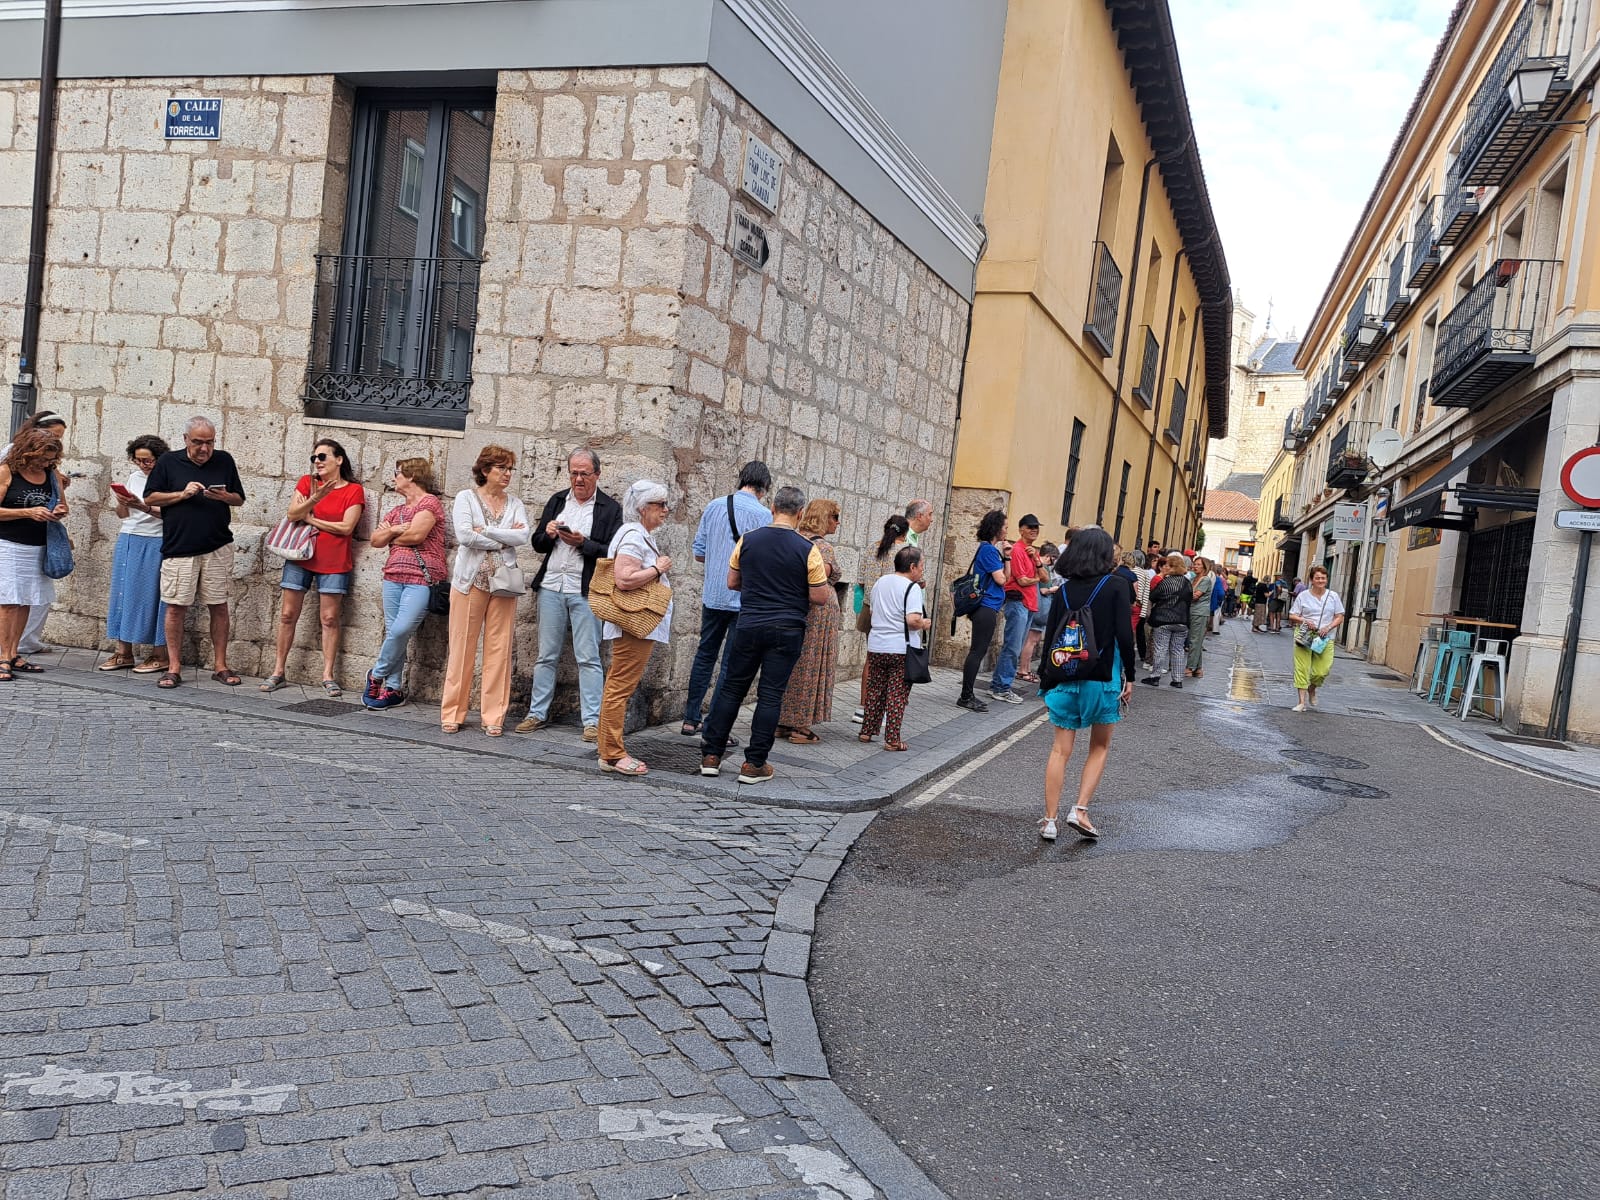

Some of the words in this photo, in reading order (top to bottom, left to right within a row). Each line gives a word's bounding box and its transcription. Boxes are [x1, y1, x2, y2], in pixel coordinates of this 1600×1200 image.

[185, 101, 219, 111] CALLE
[169, 126, 215, 136] TORRECILLA
[754, 145, 768, 164] CALLE
[769, 158, 775, 170] DE
